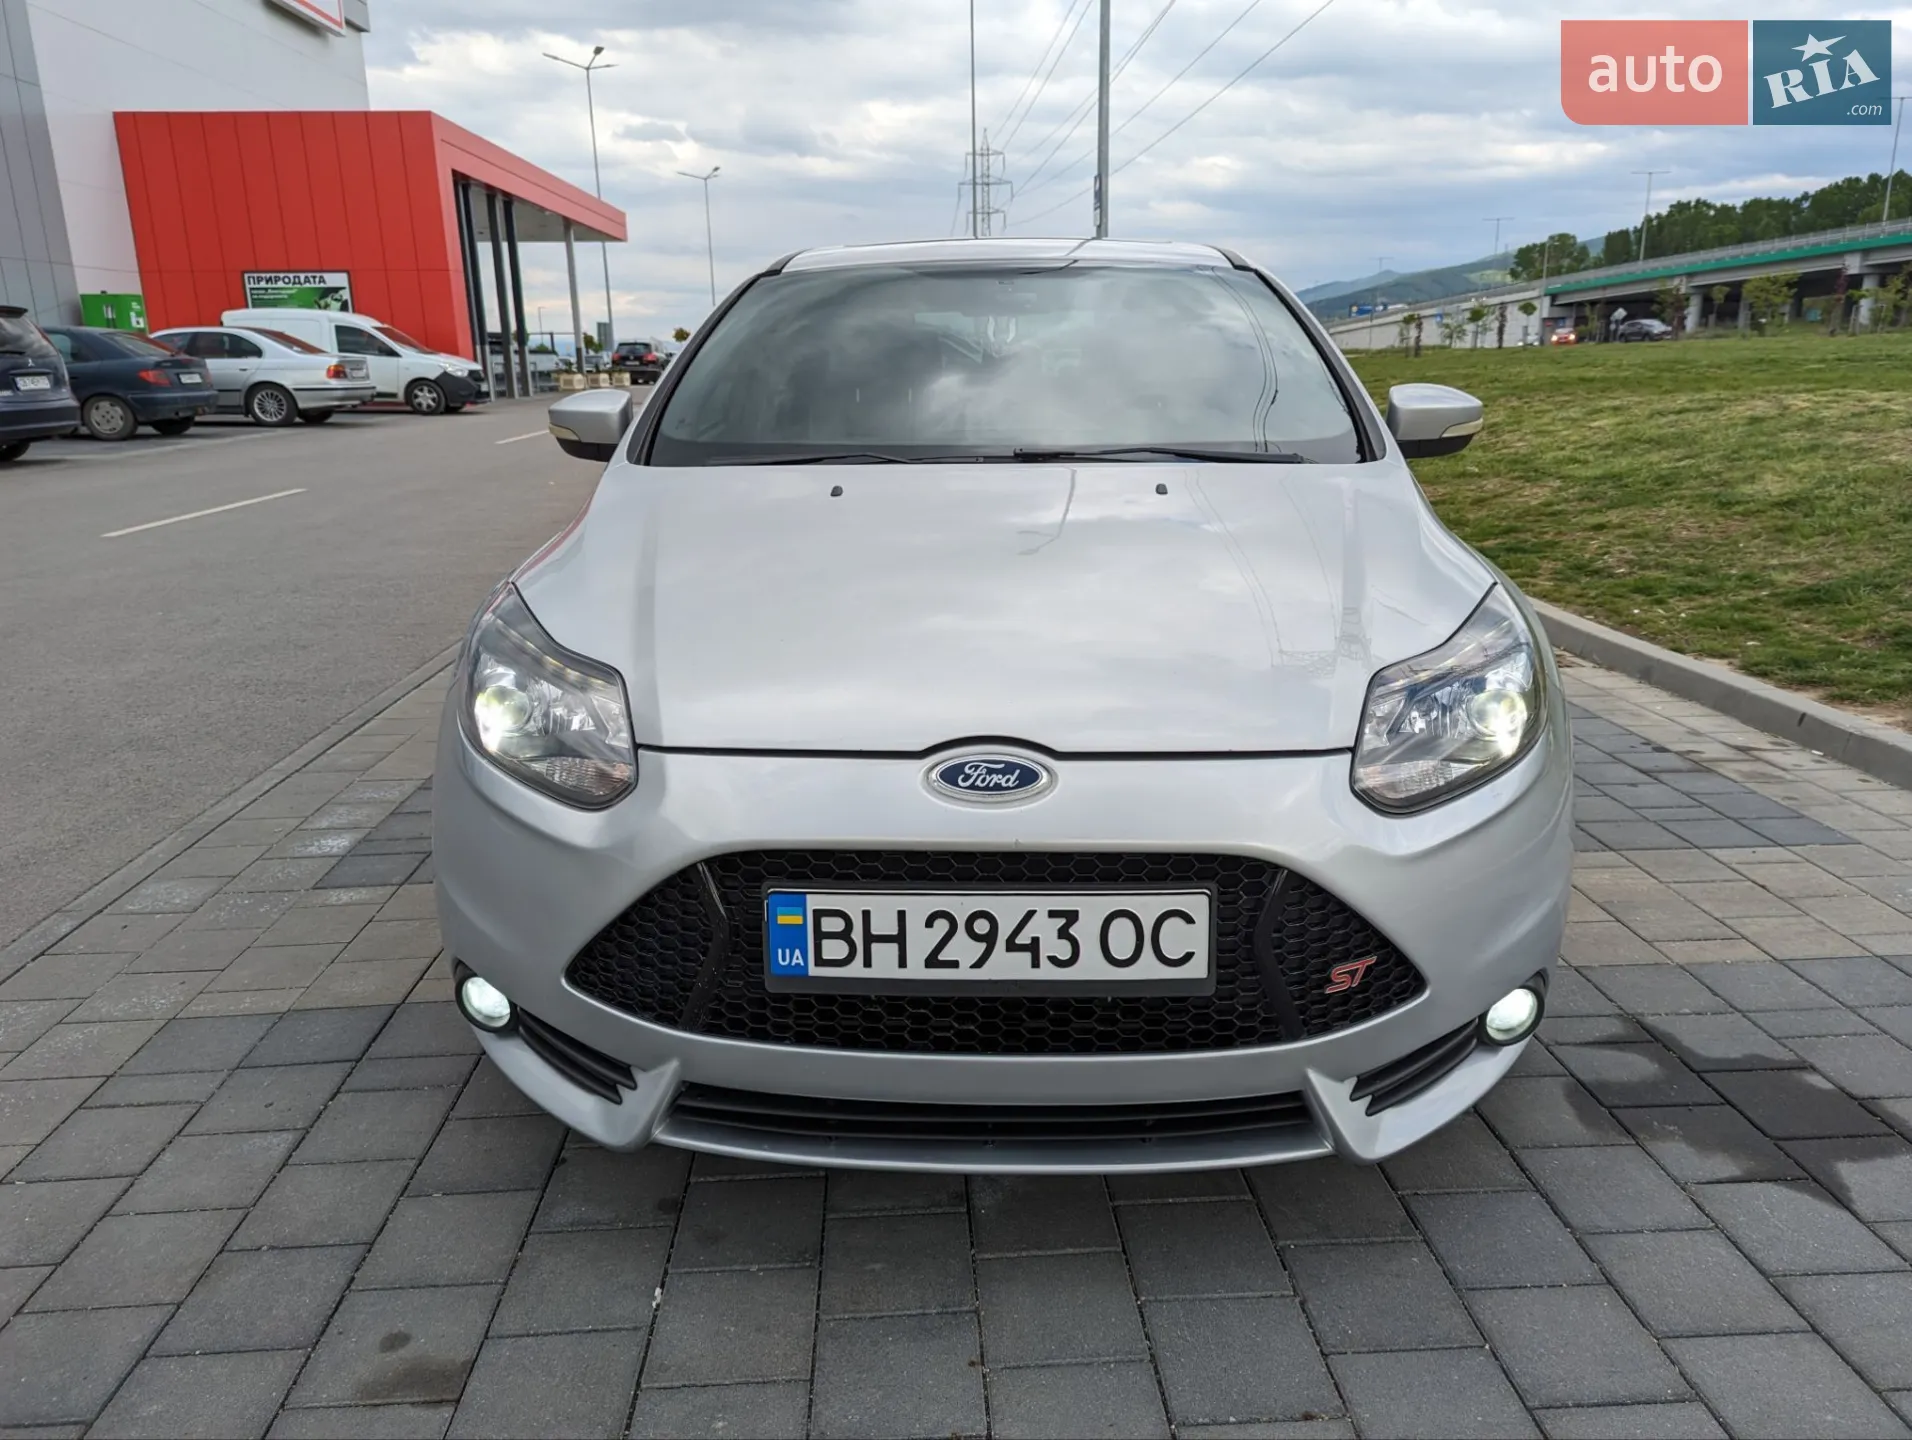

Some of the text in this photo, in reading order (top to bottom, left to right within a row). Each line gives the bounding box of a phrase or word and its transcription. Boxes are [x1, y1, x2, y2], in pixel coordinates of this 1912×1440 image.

[247, 275, 327, 286] ПРИРОДАТА
[957, 761, 1021, 788] Ford
[812, 908, 1197, 969] BH 2943 OC
[777, 948, 805, 967] UA
[1325, 955, 1378, 994] ST
